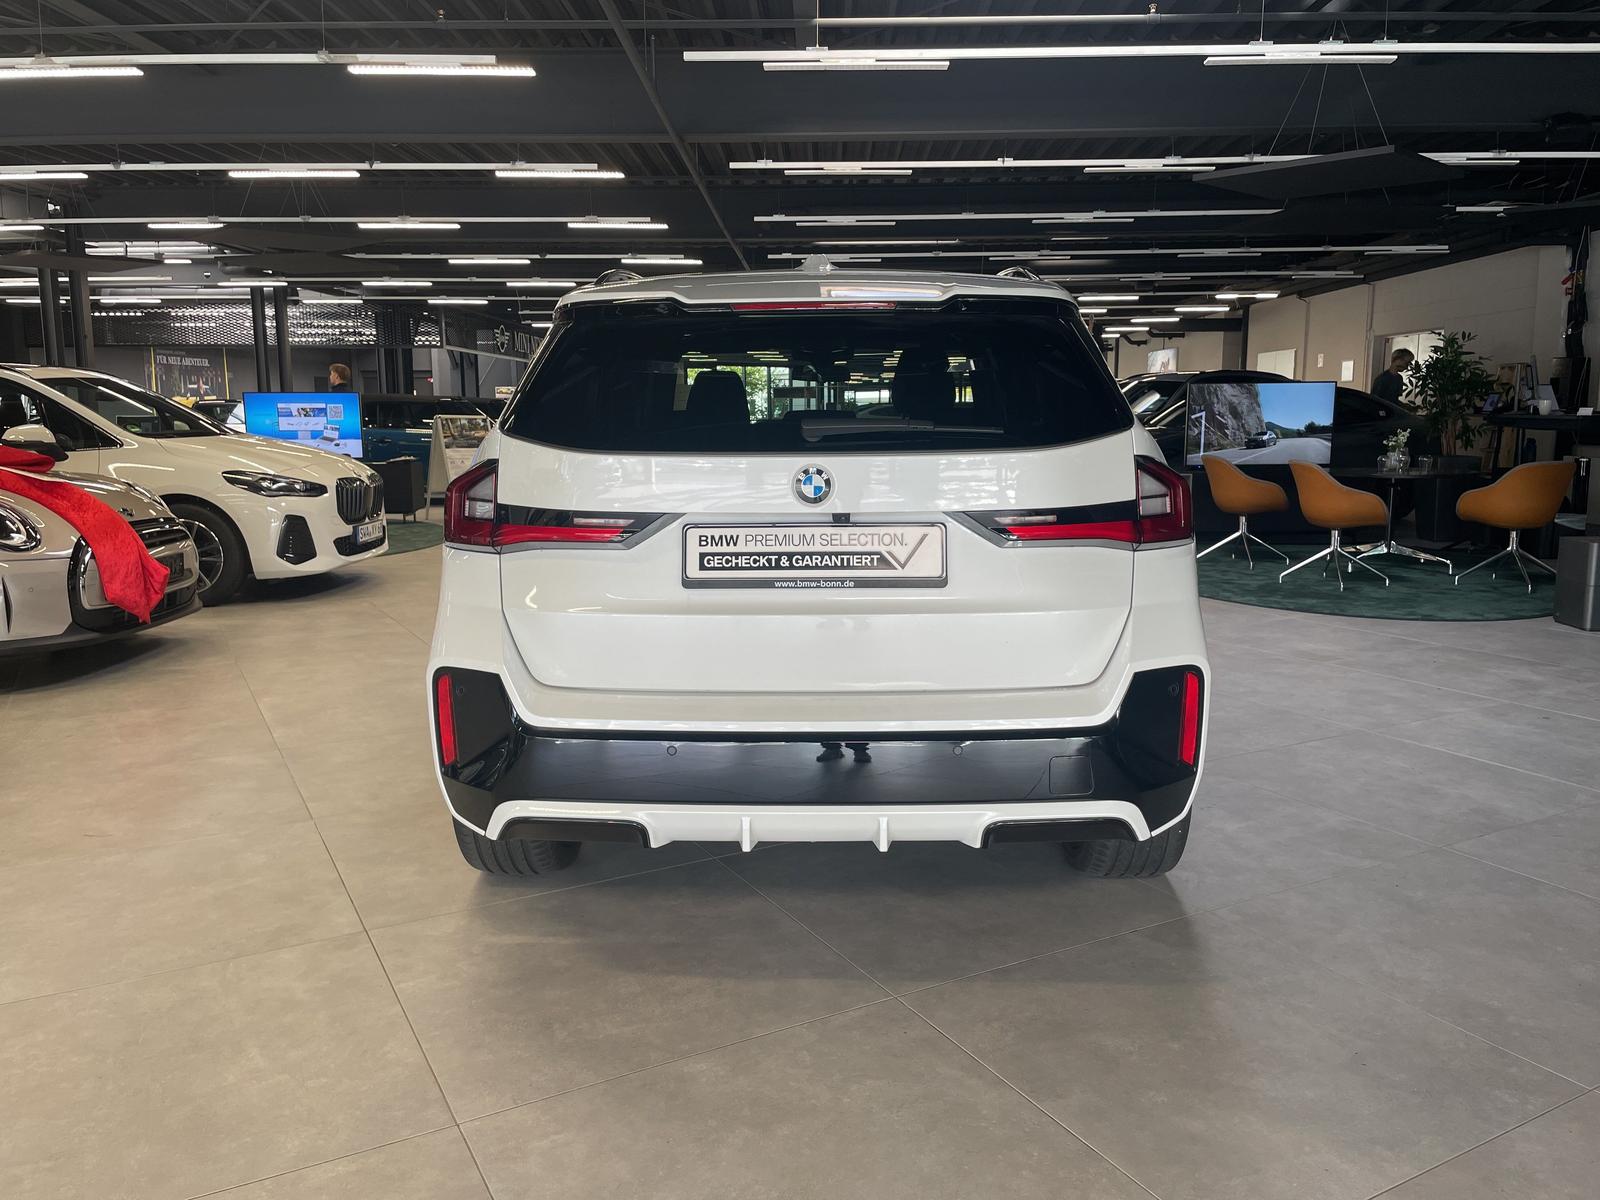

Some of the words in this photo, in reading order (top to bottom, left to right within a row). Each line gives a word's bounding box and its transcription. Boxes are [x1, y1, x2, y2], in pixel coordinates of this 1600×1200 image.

[156, 354, 168, 365] FÜR
[167, 356, 182, 366] NEUE
[182, 357, 210, 367] ABENTEUER.
[798, 467, 829, 480] BMW
[698, 534, 740, 547] BMW
[744, 533, 815, 547] PREMIUM
[819, 533, 908, 547] SELECTION.
[703, 555, 778, 568] GECHECKT
[780, 555, 790, 567] &
[792, 554, 881, 567] GARANTIERT
[774, 579, 855, 588] www.bmw-bonn.de
